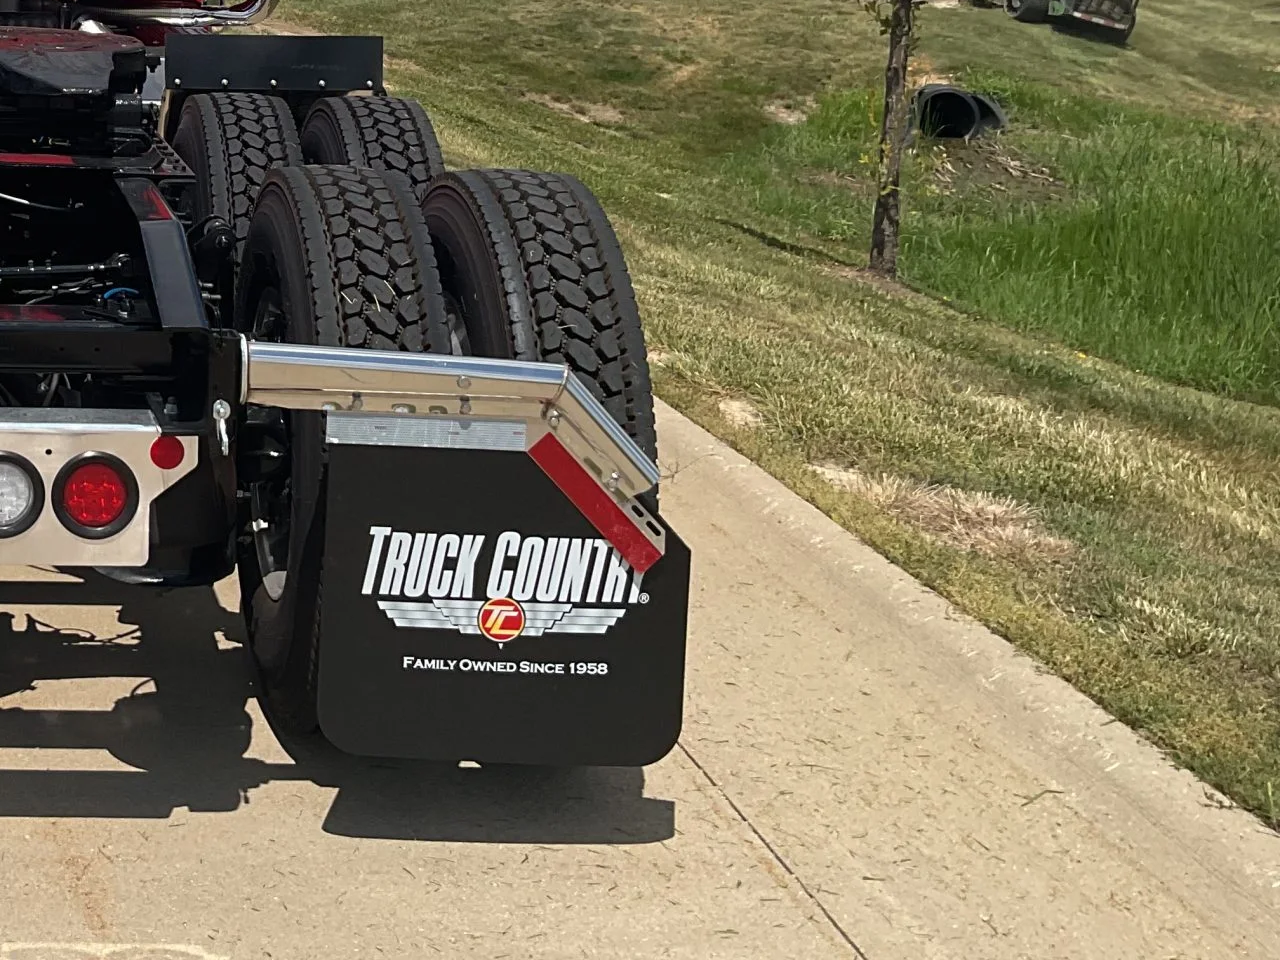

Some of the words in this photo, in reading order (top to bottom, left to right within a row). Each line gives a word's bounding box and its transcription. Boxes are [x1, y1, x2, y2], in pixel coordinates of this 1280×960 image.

[361, 526, 486, 598] TRUCK
[403, 656, 457, 671] FAMILY
[459, 658, 517, 673] OWNED
[519, 661, 565, 674] SINCE
[569, 662, 609, 675] 1958
